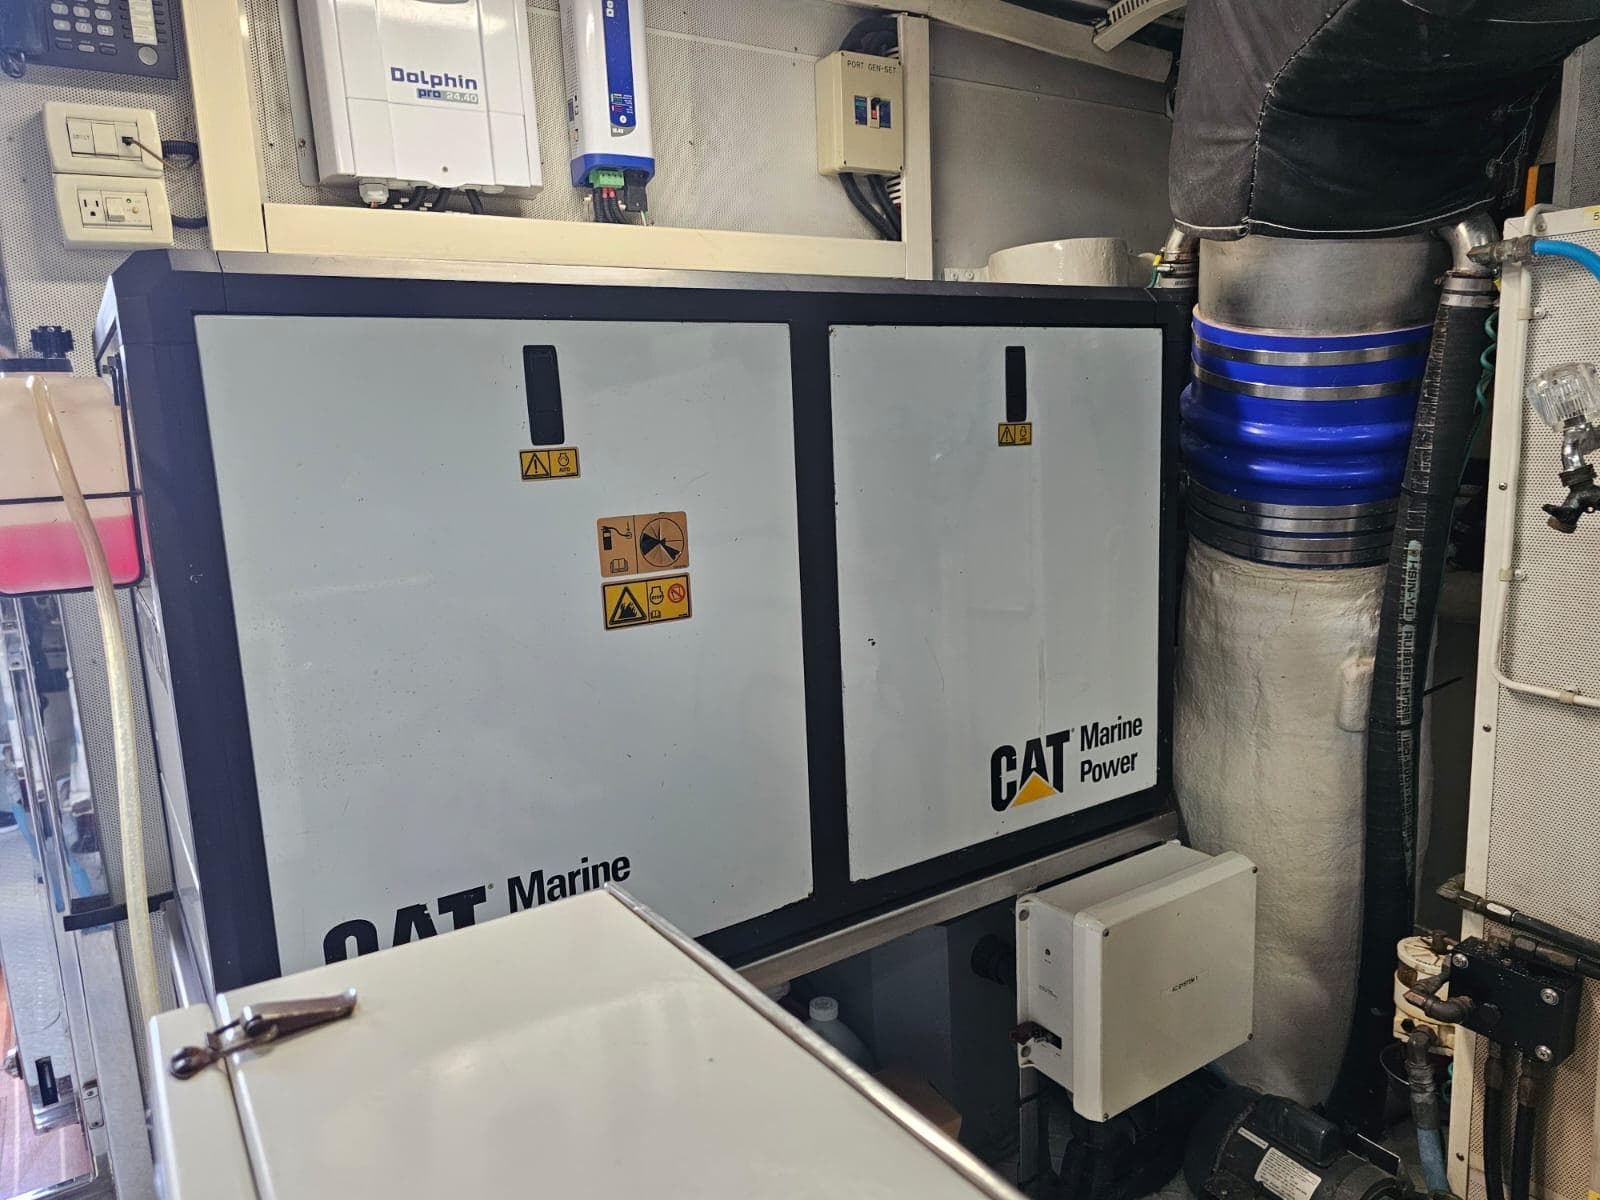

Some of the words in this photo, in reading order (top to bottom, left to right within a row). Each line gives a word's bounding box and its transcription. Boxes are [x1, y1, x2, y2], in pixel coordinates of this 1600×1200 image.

[390, 66, 478, 90] Dolphin
[847, 60, 864, 69] PORT
[868, 63, 897, 74] GEN-SET
[418, 88, 441, 99] pro
[446, 91, 478, 103] 24.40
[1405, 560, 1418, 615] HSIN-YU
[1402, 630, 1413, 680] RUBBER
[990, 729, 1070, 812] CAT
[1080, 715, 1143, 752] Marine
[1080, 752, 1138, 783] Power
[507, 855, 631, 913] Marine
